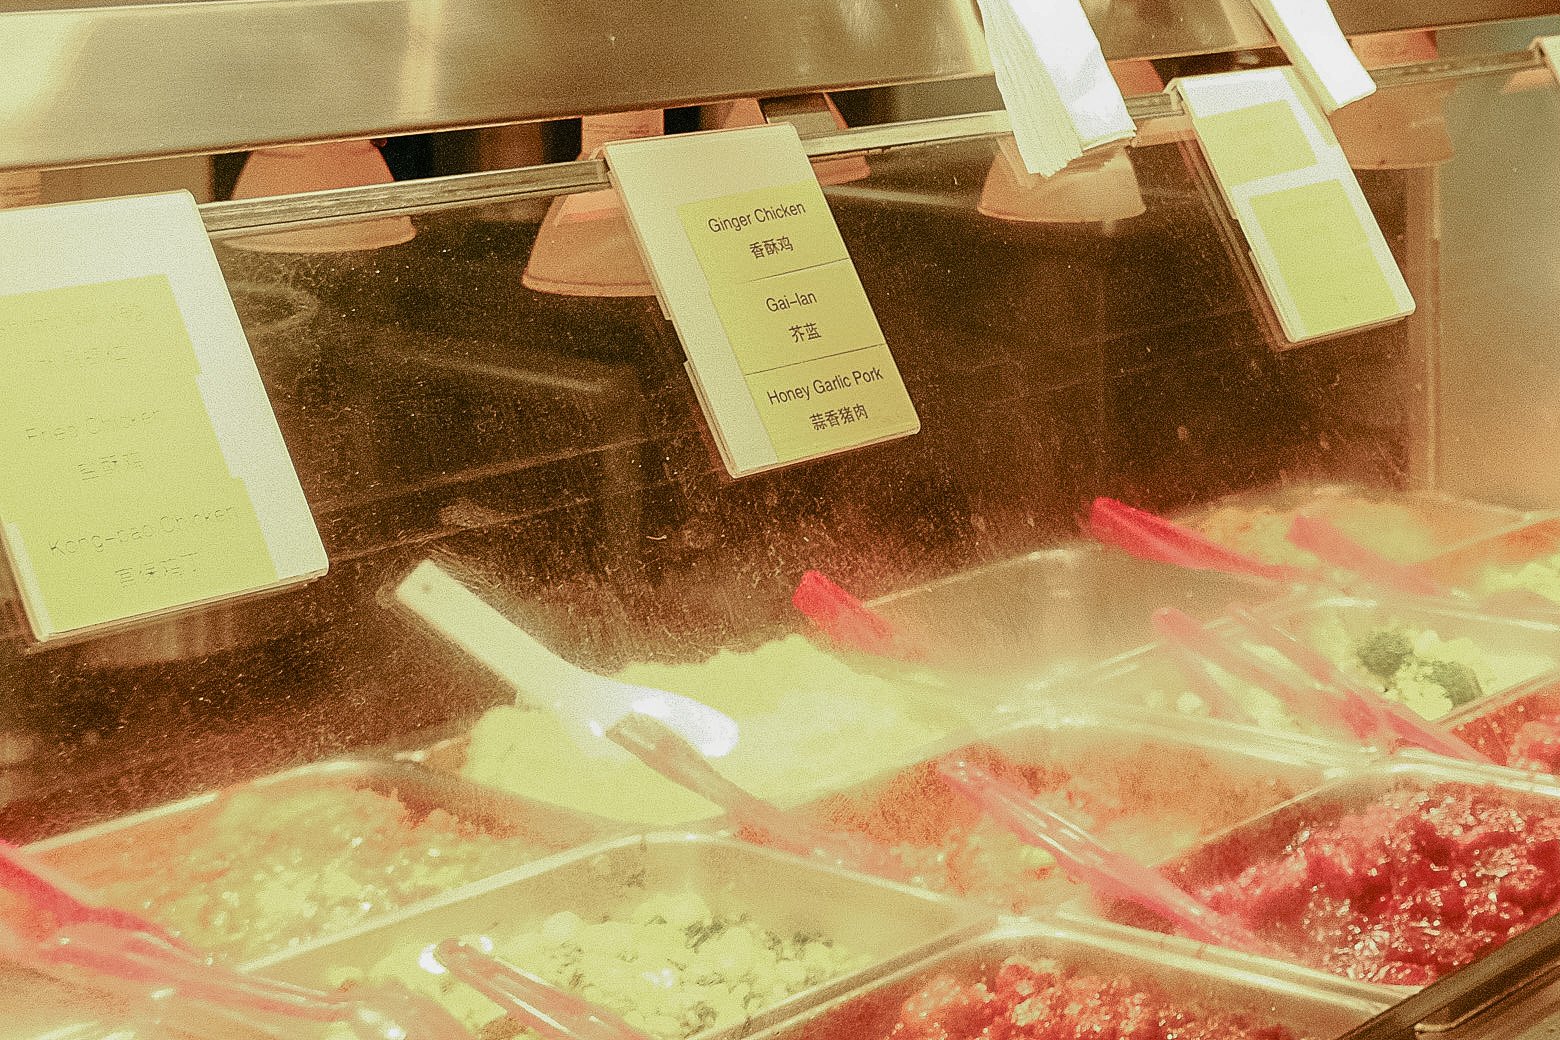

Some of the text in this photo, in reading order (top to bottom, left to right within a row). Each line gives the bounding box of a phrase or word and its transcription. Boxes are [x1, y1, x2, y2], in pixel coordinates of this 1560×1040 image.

[706, 201, 806, 234] Ginger Chicken
[749, 236, 794, 260] 香酥鸡
[765, 291, 818, 313] Gai-lan
[789, 322, 822, 344] 芥蓝
[767, 365, 885, 408] Honey Garlic Pork
[808, 403, 869, 432] 蒜香猪肉
